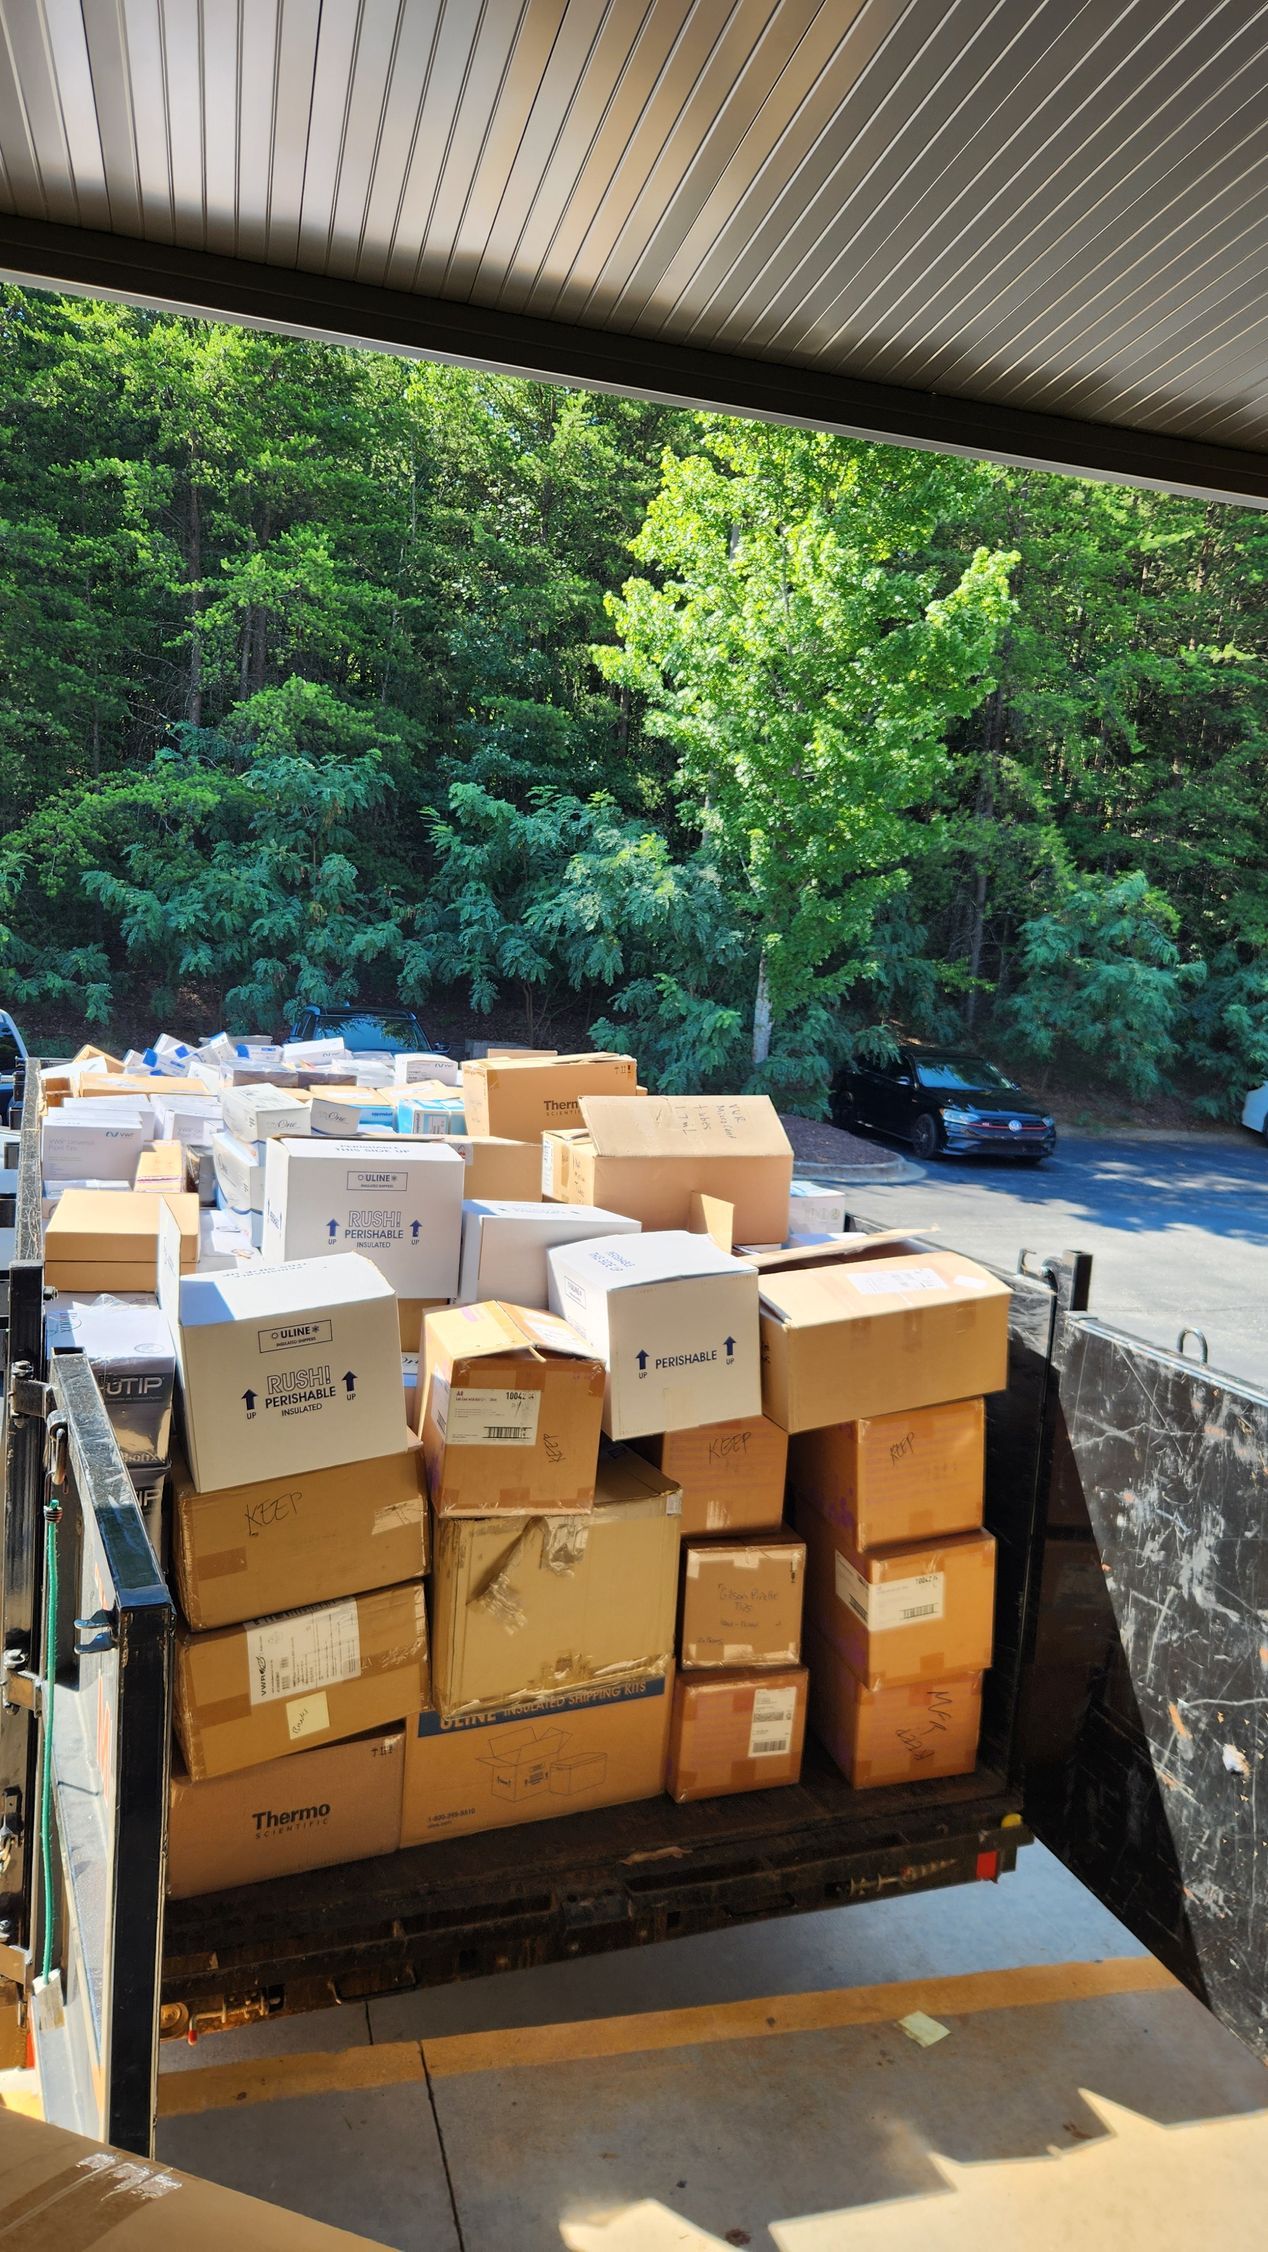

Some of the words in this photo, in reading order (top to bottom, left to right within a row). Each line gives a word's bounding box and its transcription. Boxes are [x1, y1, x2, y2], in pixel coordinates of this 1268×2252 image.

[543, 1100, 579, 1110] Therm
[365, 1174, 391, 1182] ULINE
[349, 1211, 402, 1228] RUSH!
[344, 1229, 404, 1240] PERISHABLE
[356, 1241, 391, 1249] INSULATED
[280, 1326, 311, 1339] ULINE
[655, 1350, 718, 1369] PERISHABLE
[267, 1365, 332, 1395] RUSH!
[265, 1386, 337, 1408] PERISHABLE
[346, 1393, 357, 1401] UP
[246, 1412, 257, 1420] UP
[281, 1403, 323, 1416] INSULATED
[543, 1434, 567, 1463] KEEP
[709, 1431, 752, 1465] KEEP
[244, 1491, 303, 1536] KEEP
[567, 1685, 621, 1705] SHIPPING
[624, 1681, 647, 1696] KITS
[252, 1803, 331, 1830] Thermo
[255, 1817, 329, 1840] SCIENTIFIC
